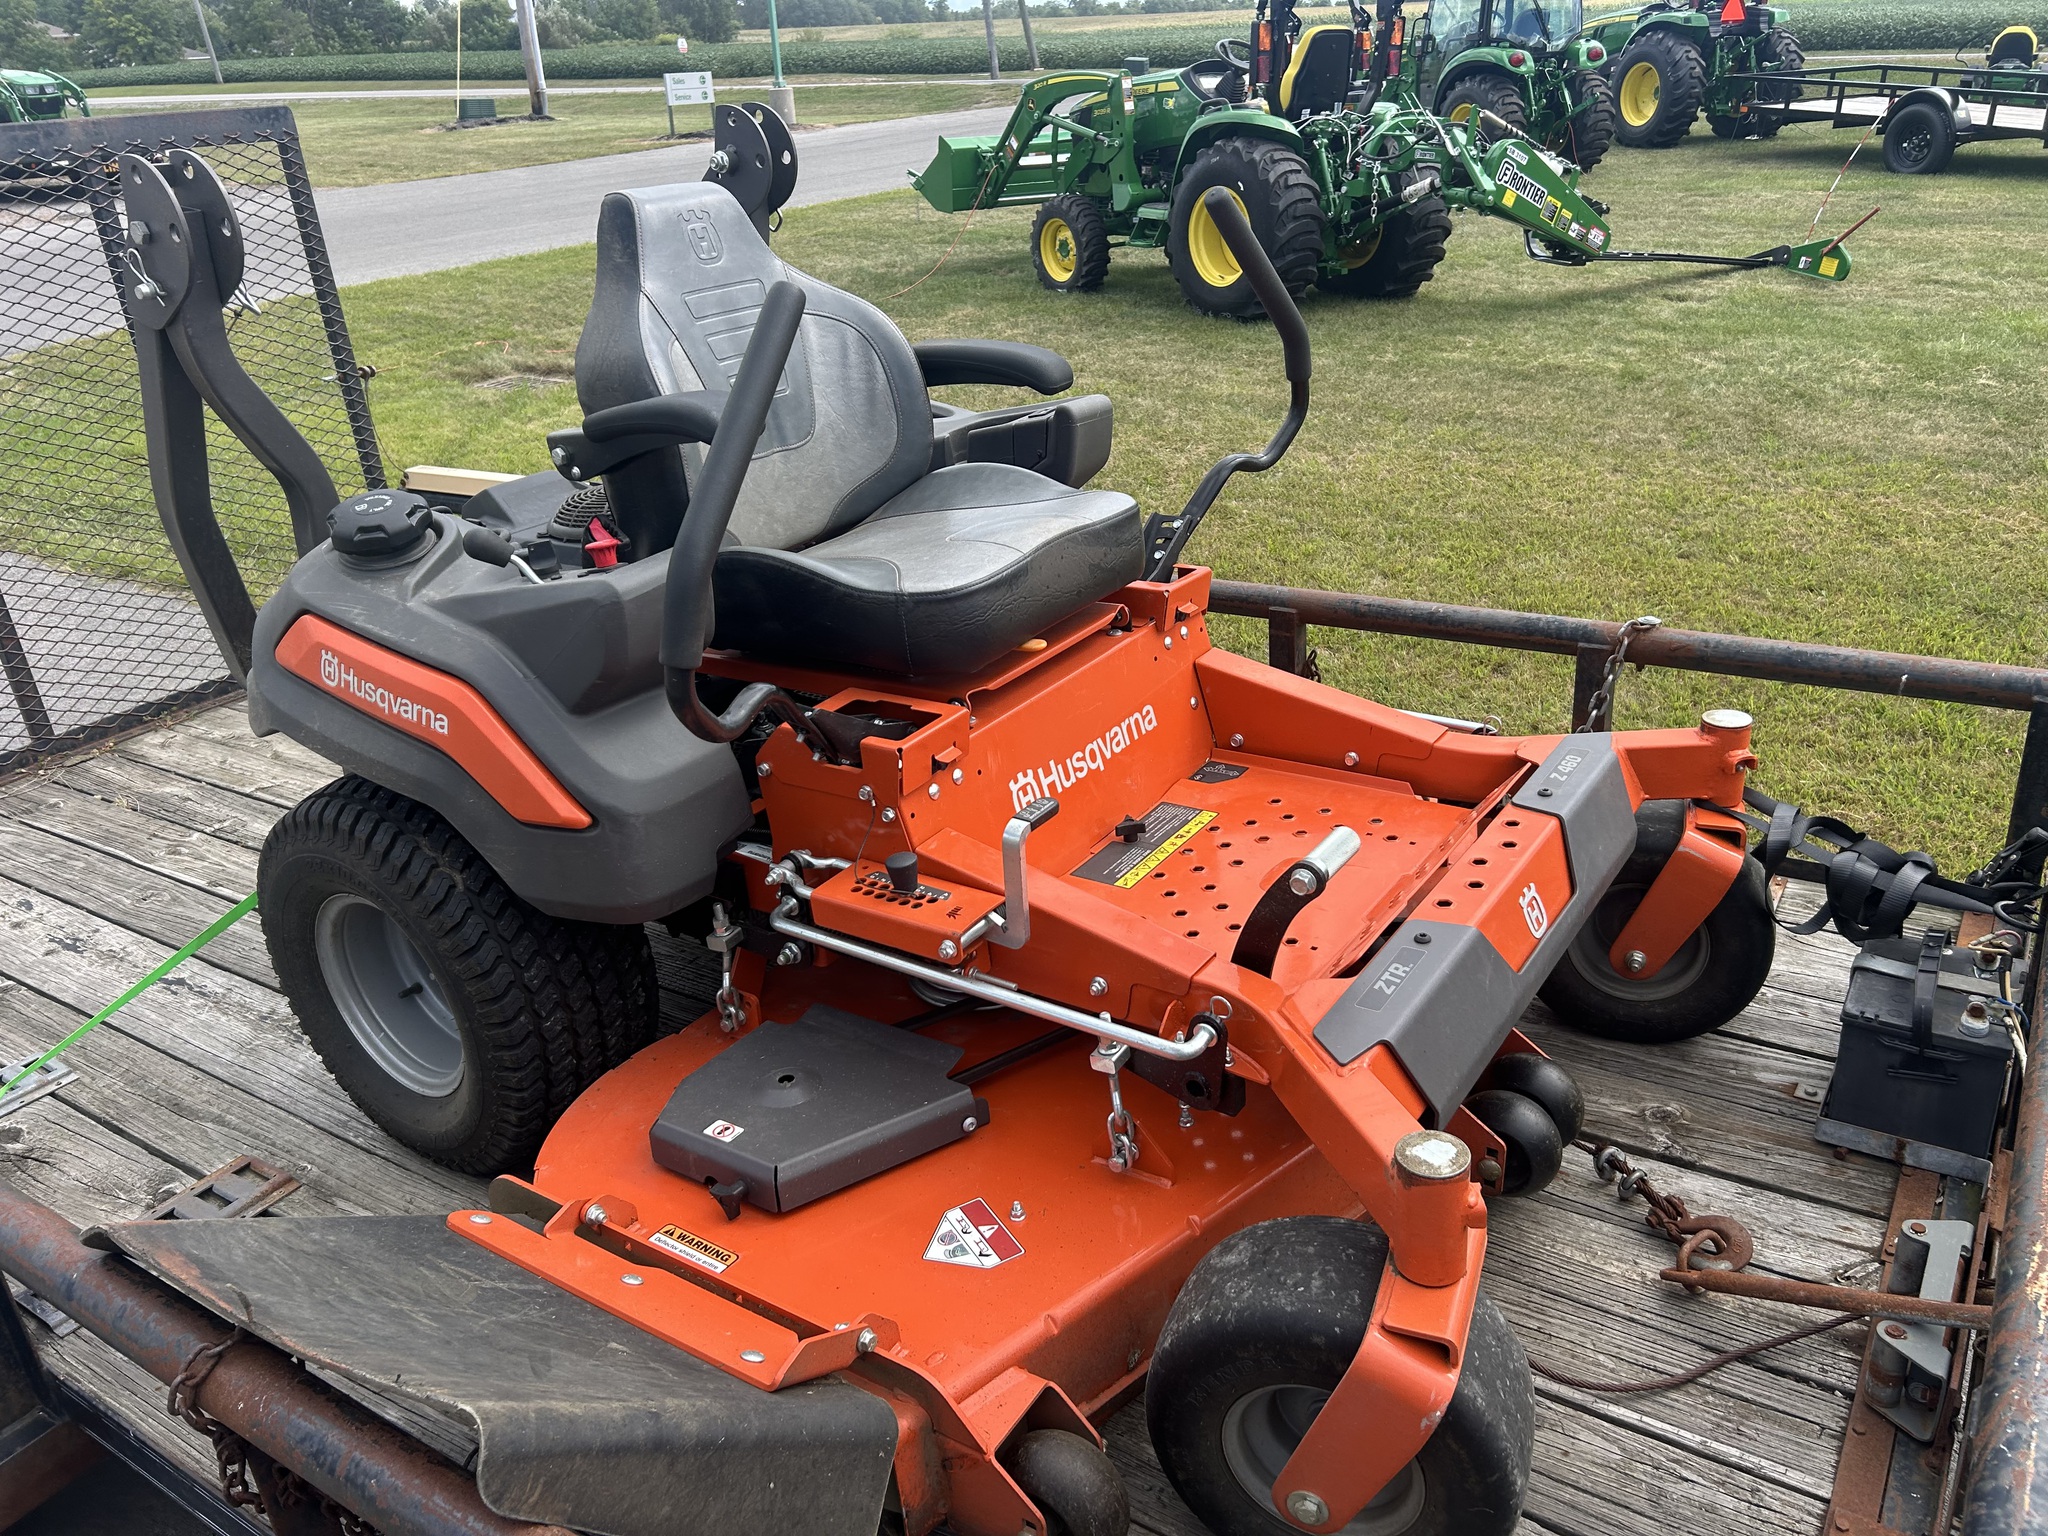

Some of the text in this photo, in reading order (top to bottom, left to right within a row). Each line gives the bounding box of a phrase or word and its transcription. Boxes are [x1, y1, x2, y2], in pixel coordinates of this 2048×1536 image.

[672, 77, 686, 85] Sales
[674, 93, 692, 101] Service
[1498, 160, 1546, 206] FRONTIER
[340, 663, 448, 735] Husqvarna
[1037, 704, 1158, 798] Husqvarna
[1550, 754, 1582, 782] Z 460
[654, 1236, 679, 1251] Deflector
[679, 1248, 698, 1260] shield
[701, 1259, 719, 1270] entire
[677, 1231, 732, 1262] WARNING
